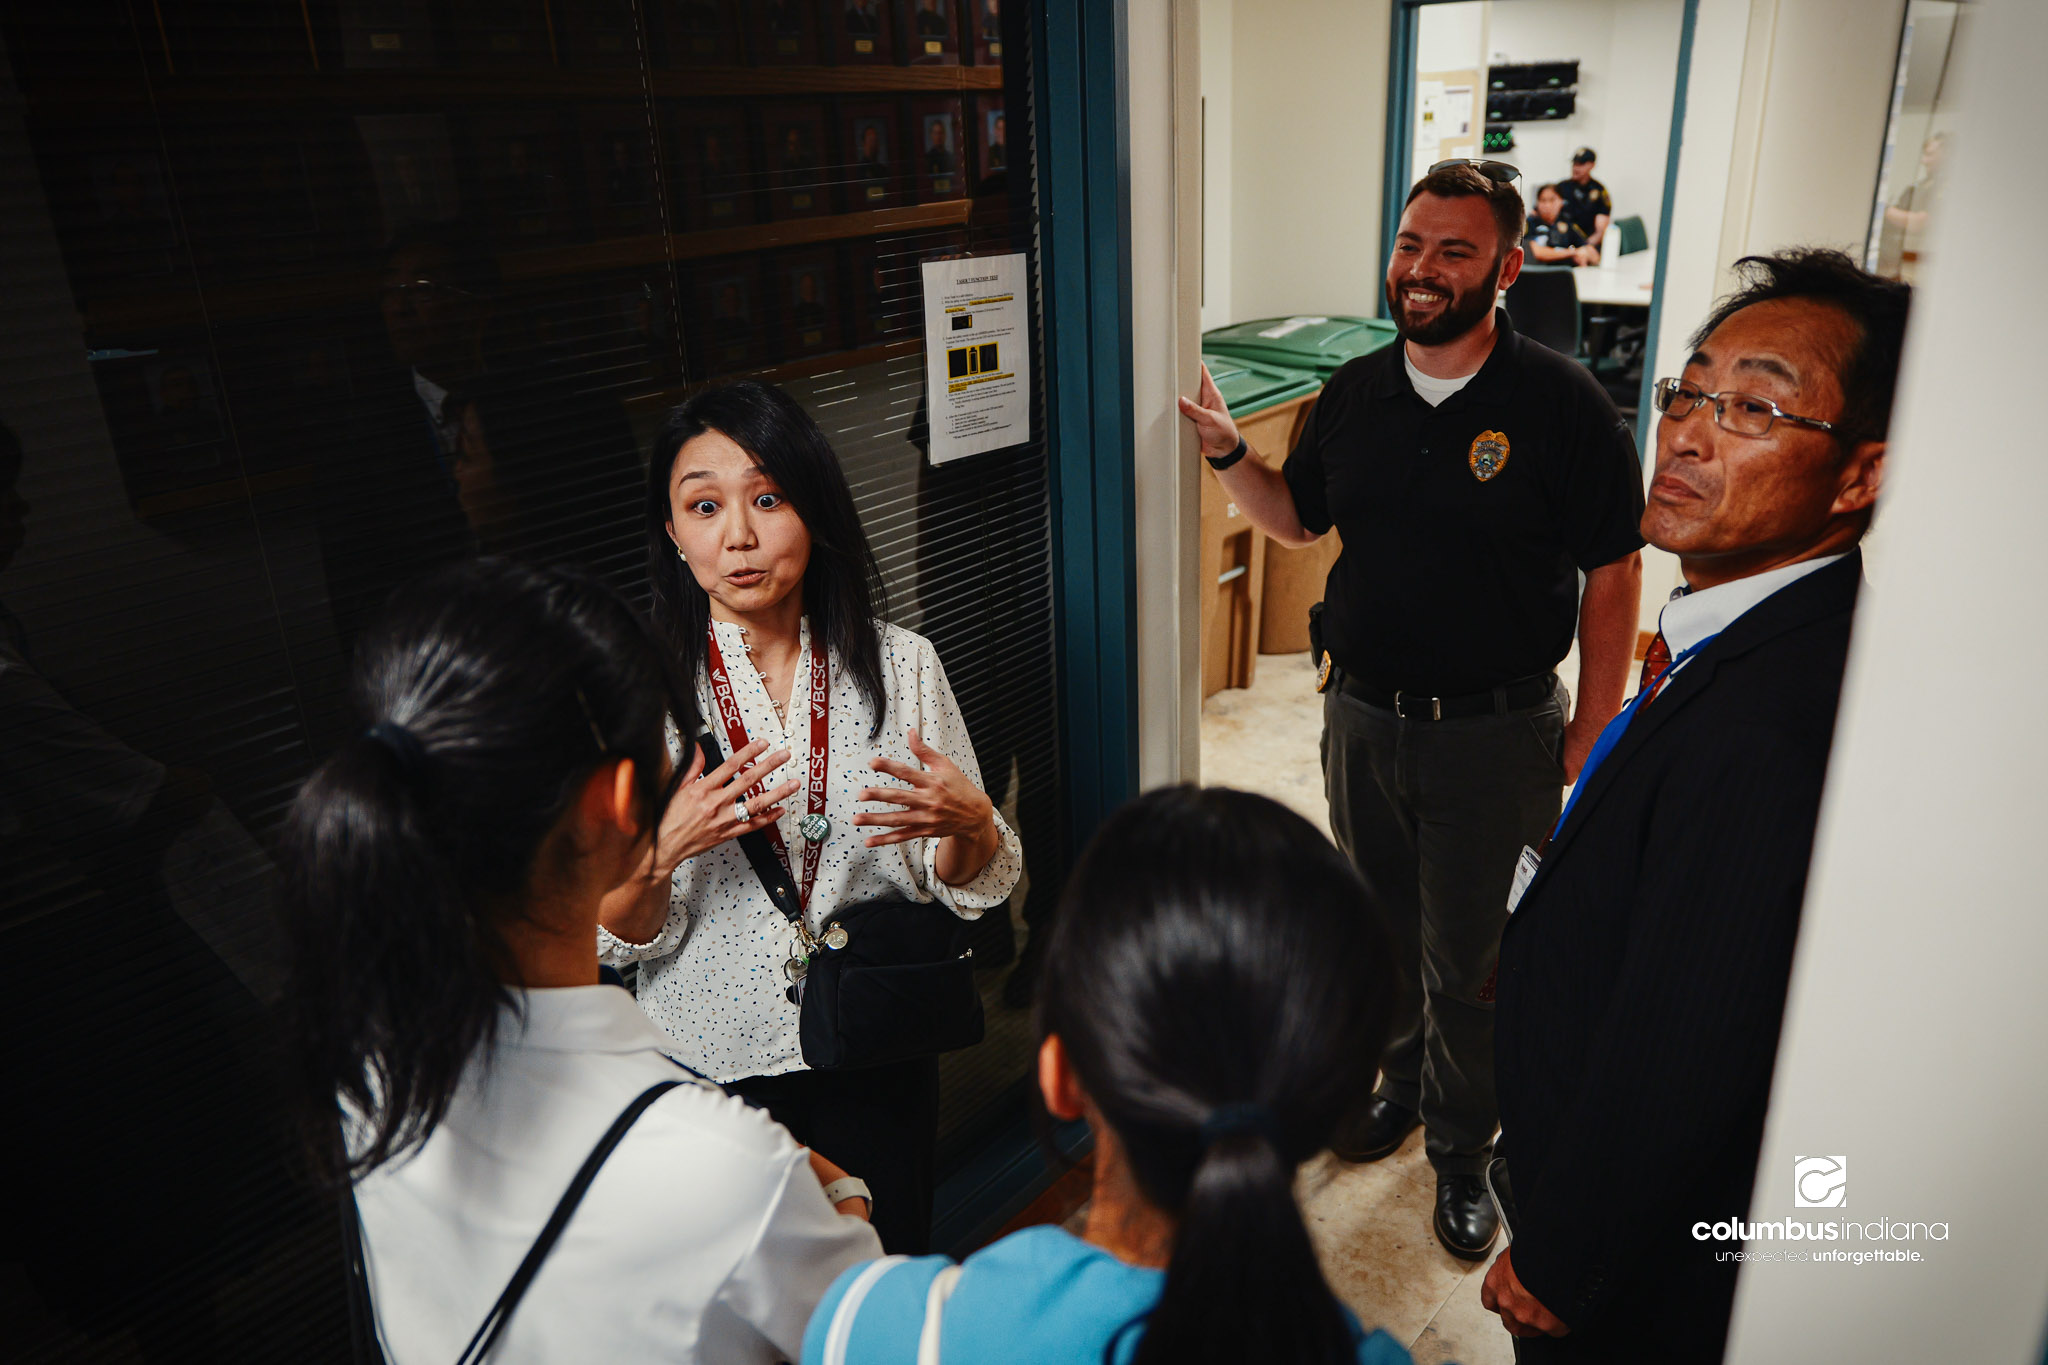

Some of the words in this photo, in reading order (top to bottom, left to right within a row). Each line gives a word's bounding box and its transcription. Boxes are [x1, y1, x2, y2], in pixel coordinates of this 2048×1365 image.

[812, 657, 826, 702] BCSC
[715, 682, 741, 730] BCSC
[810, 746, 825, 793] BCSC
[802, 815, 820, 834] Good
[803, 840, 820, 882] BCSC
